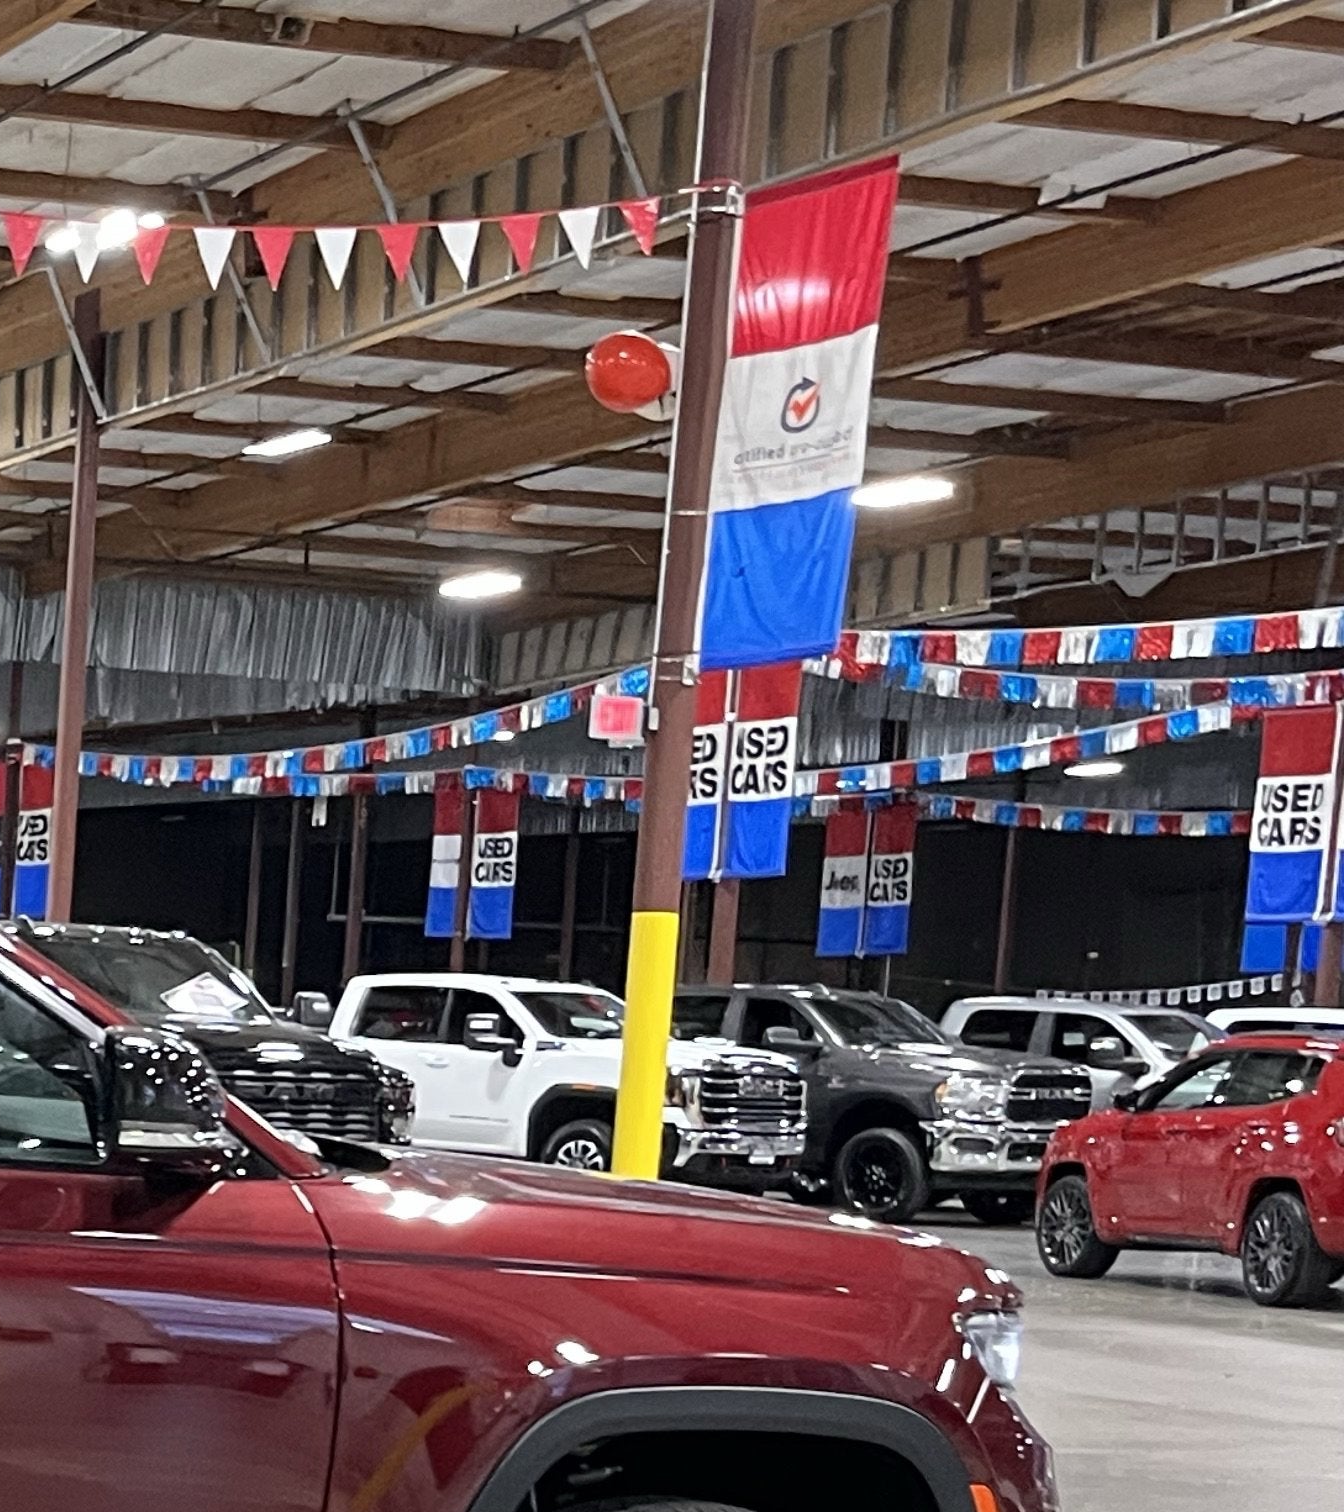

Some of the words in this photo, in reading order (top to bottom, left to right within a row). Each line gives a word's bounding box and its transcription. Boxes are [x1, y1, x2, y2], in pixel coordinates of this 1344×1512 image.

[691, 733, 717, 764] ED
[1261, 783, 1324, 814] USED
[1257, 816, 1321, 847] CARS
[17, 839, 48, 861] CAS
